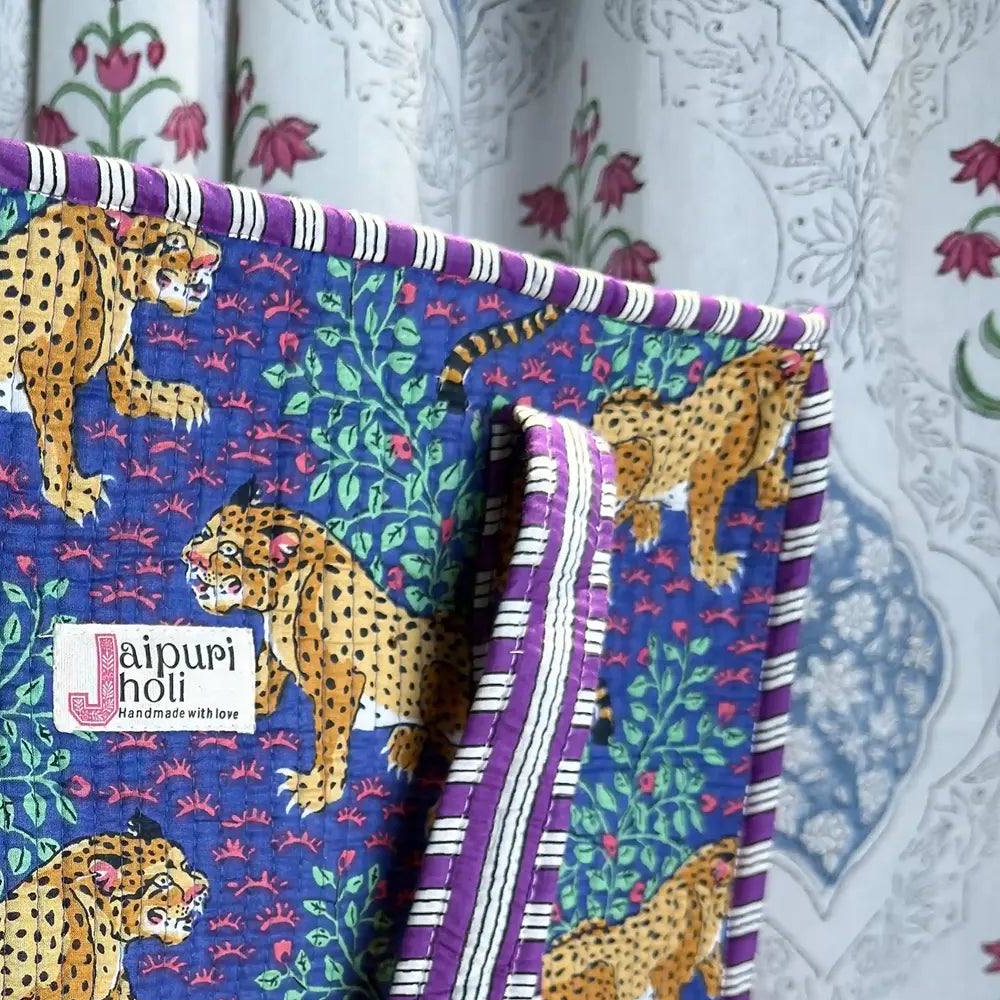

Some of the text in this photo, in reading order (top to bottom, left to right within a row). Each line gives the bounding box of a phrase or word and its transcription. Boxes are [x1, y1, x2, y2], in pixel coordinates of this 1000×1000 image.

[69, 633, 236, 726] Jaipuri
[118, 707, 239, 720] Handmade with love
